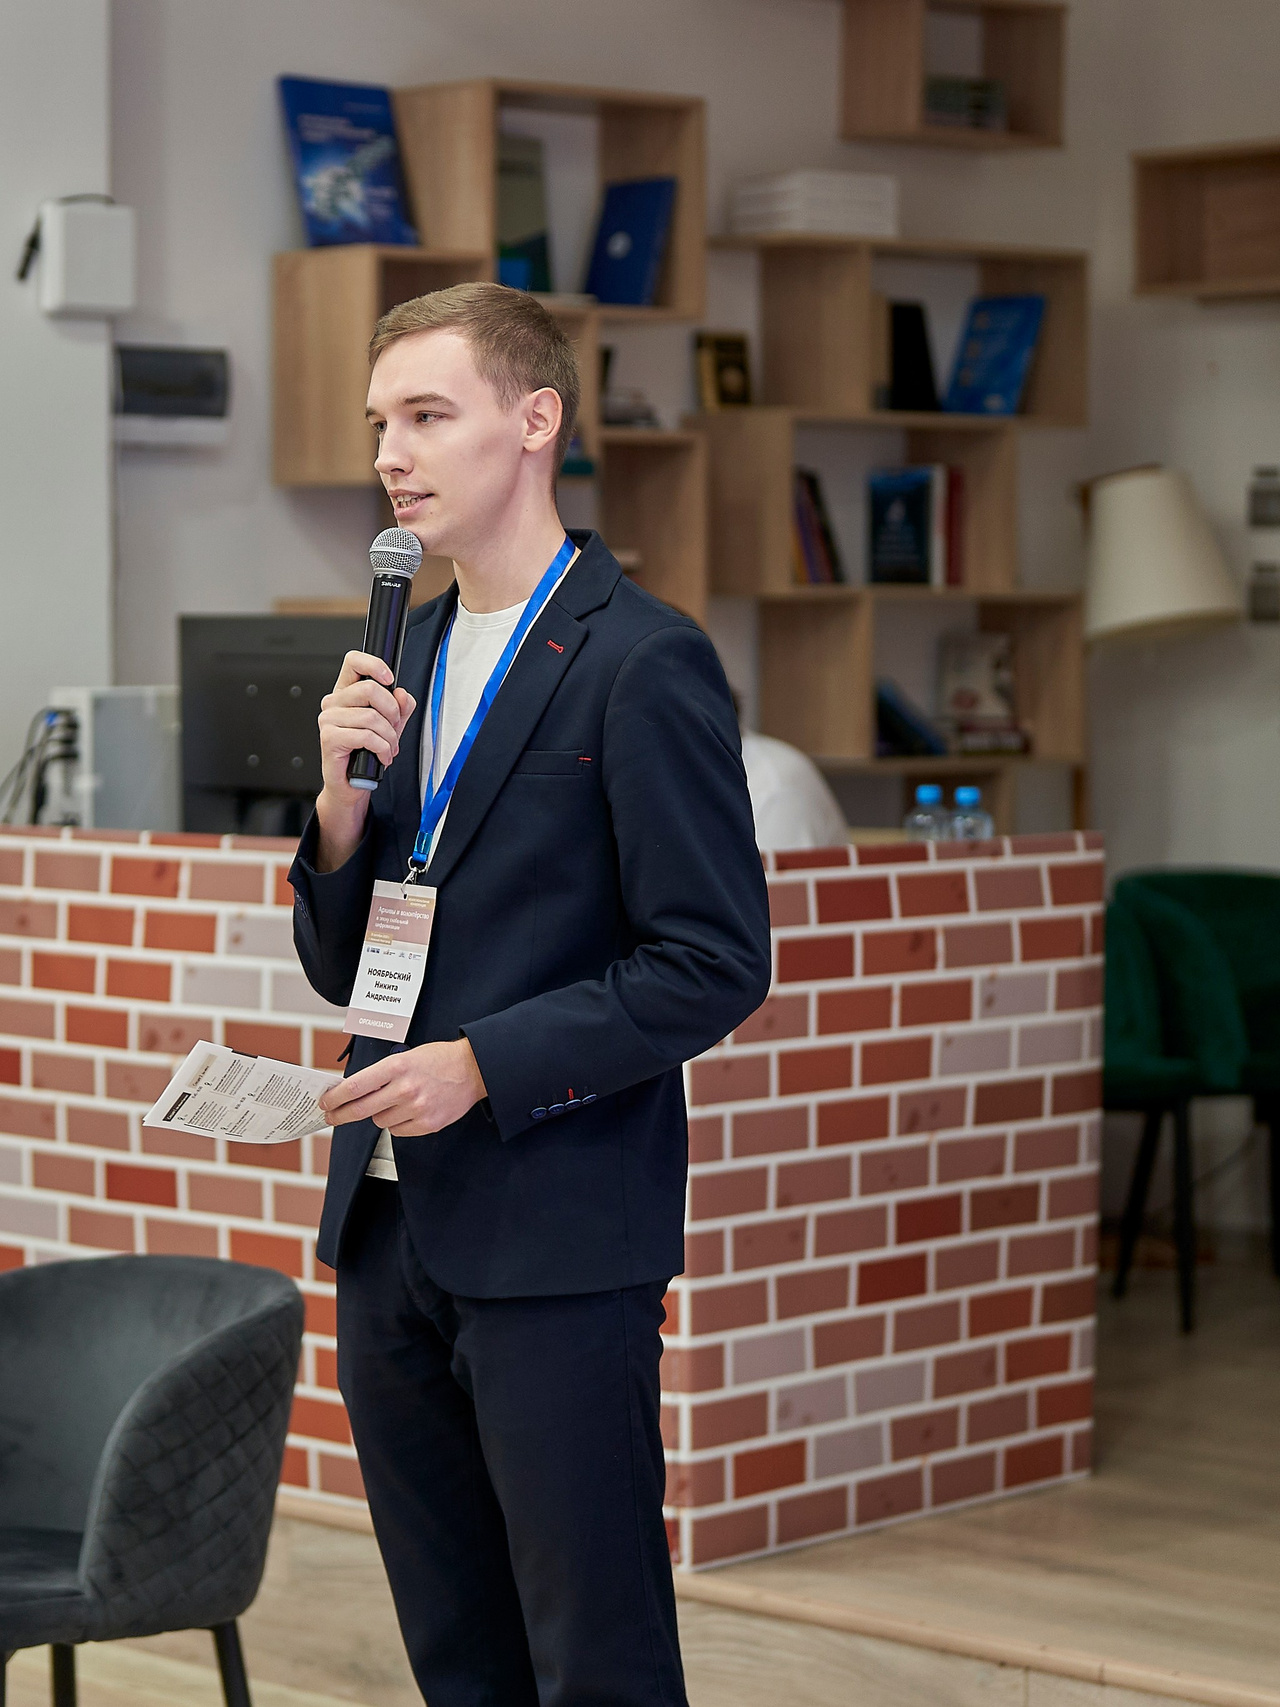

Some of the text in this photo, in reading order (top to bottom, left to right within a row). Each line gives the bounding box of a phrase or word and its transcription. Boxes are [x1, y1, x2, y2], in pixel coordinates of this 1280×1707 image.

[367, 967, 412, 982] НОЯБРЬСКИЙ
[374, 980, 399, 992] Никита
[365, 990, 402, 1004] Андреевич
[358, 1017, 395, 1030] ОРГАНИЗАТОР
